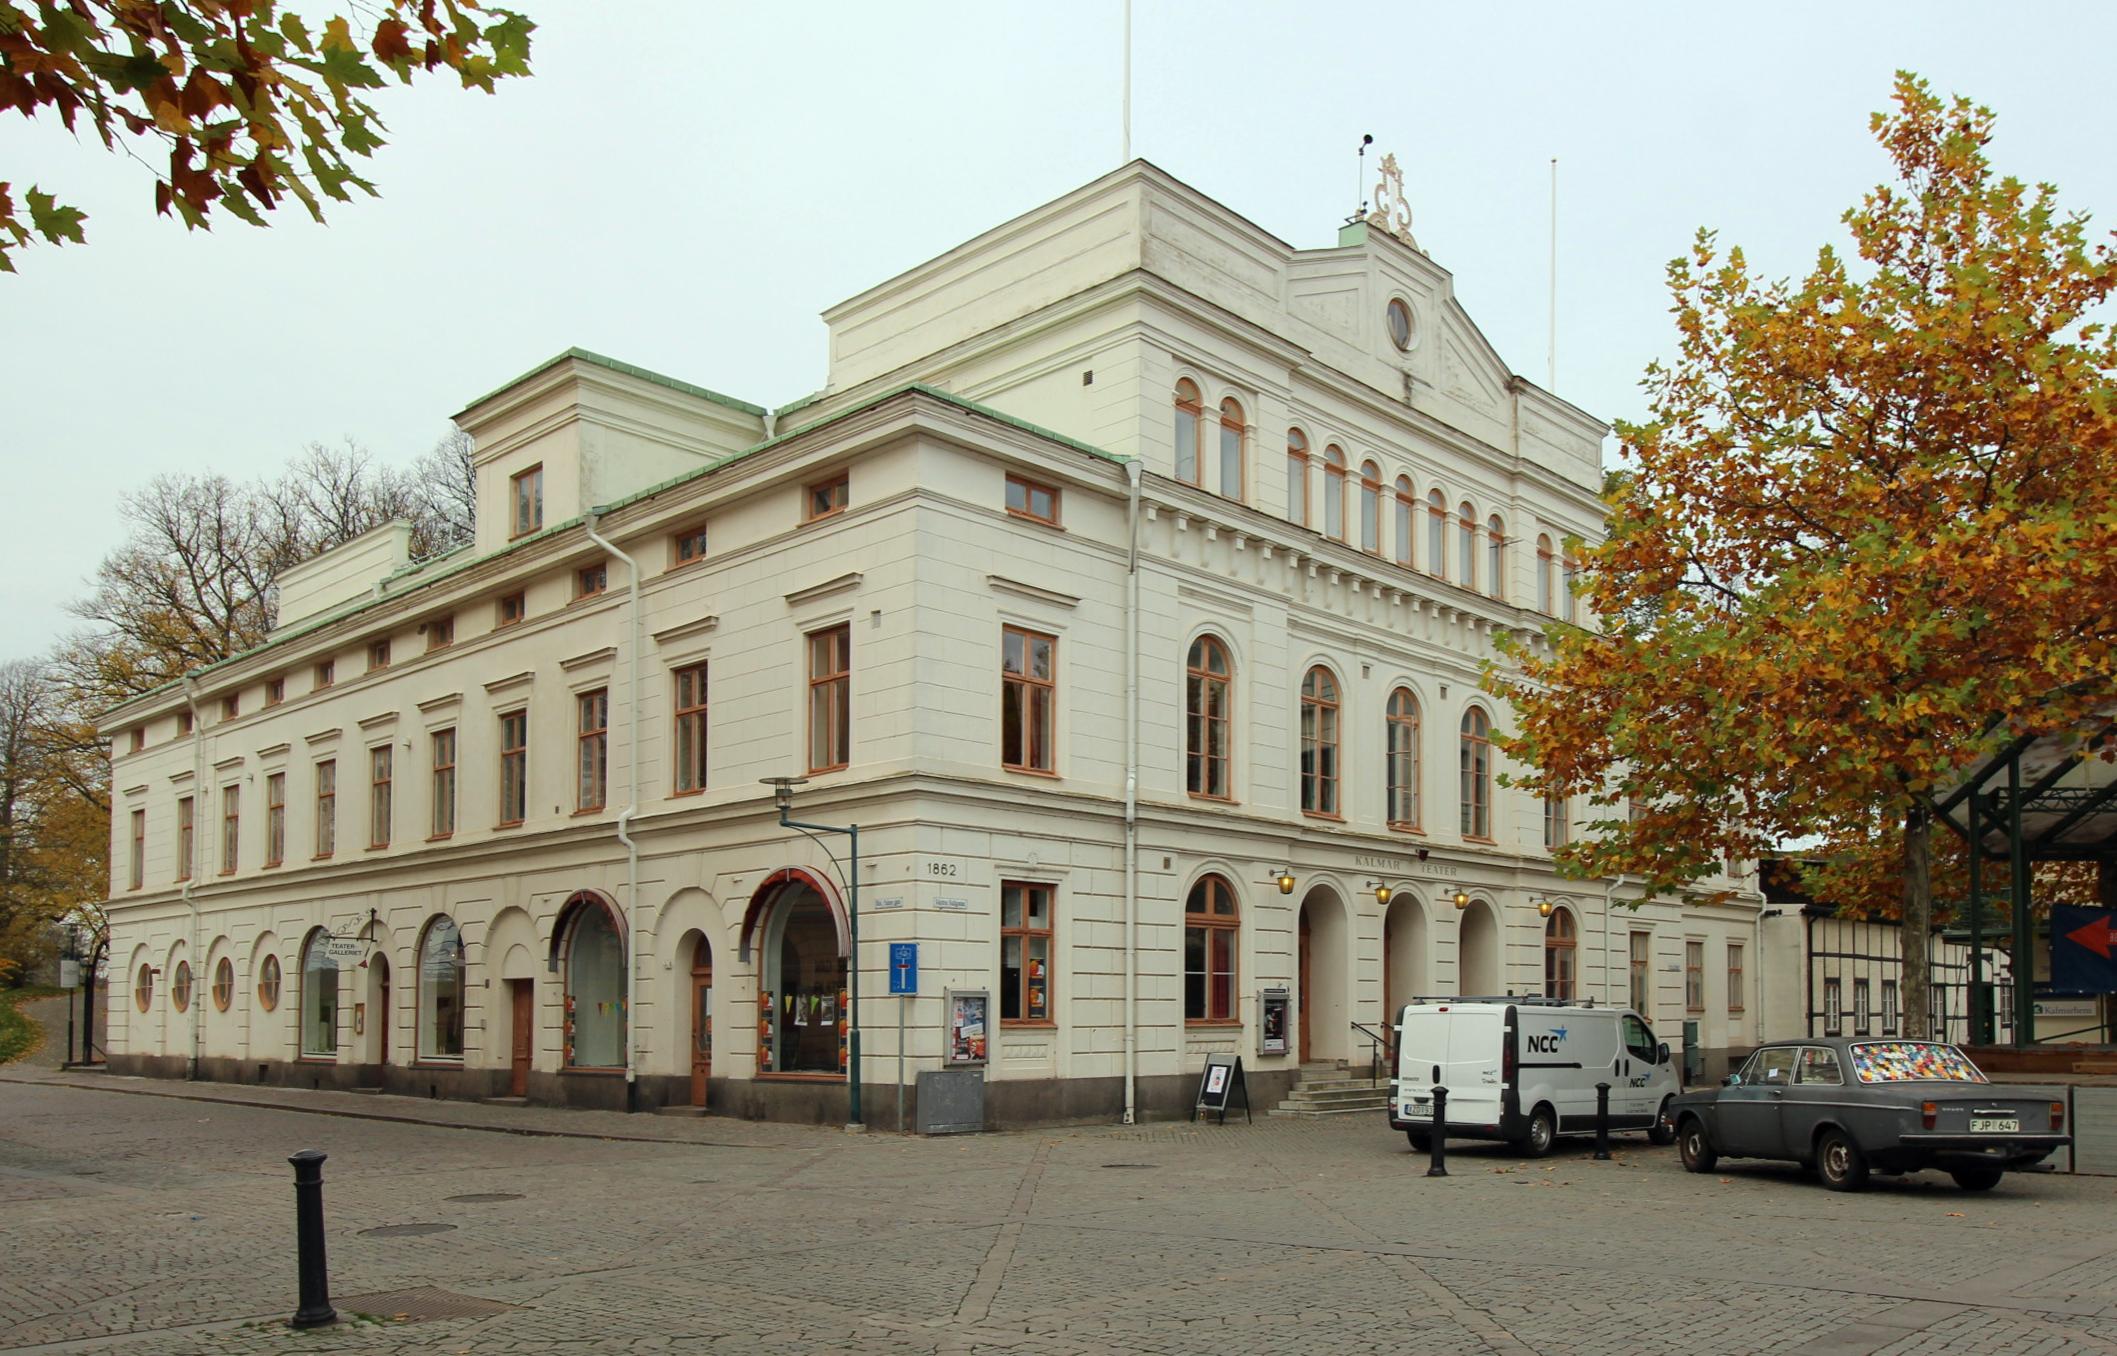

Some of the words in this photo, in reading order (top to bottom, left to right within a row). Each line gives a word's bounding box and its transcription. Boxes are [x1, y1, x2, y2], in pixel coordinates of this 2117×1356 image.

[927, 863, 957, 876] 1862
[1355, 855, 1400, 870] KALMAR
[1421, 863, 1457, 876] TEATER
[1527, 1035, 1558, 1053] NCC
[1629, 1078, 1646, 1088] NCC
[1971, 1120, 1991, 1130] FJP
[1998, 1120, 2018, 1130] 647
